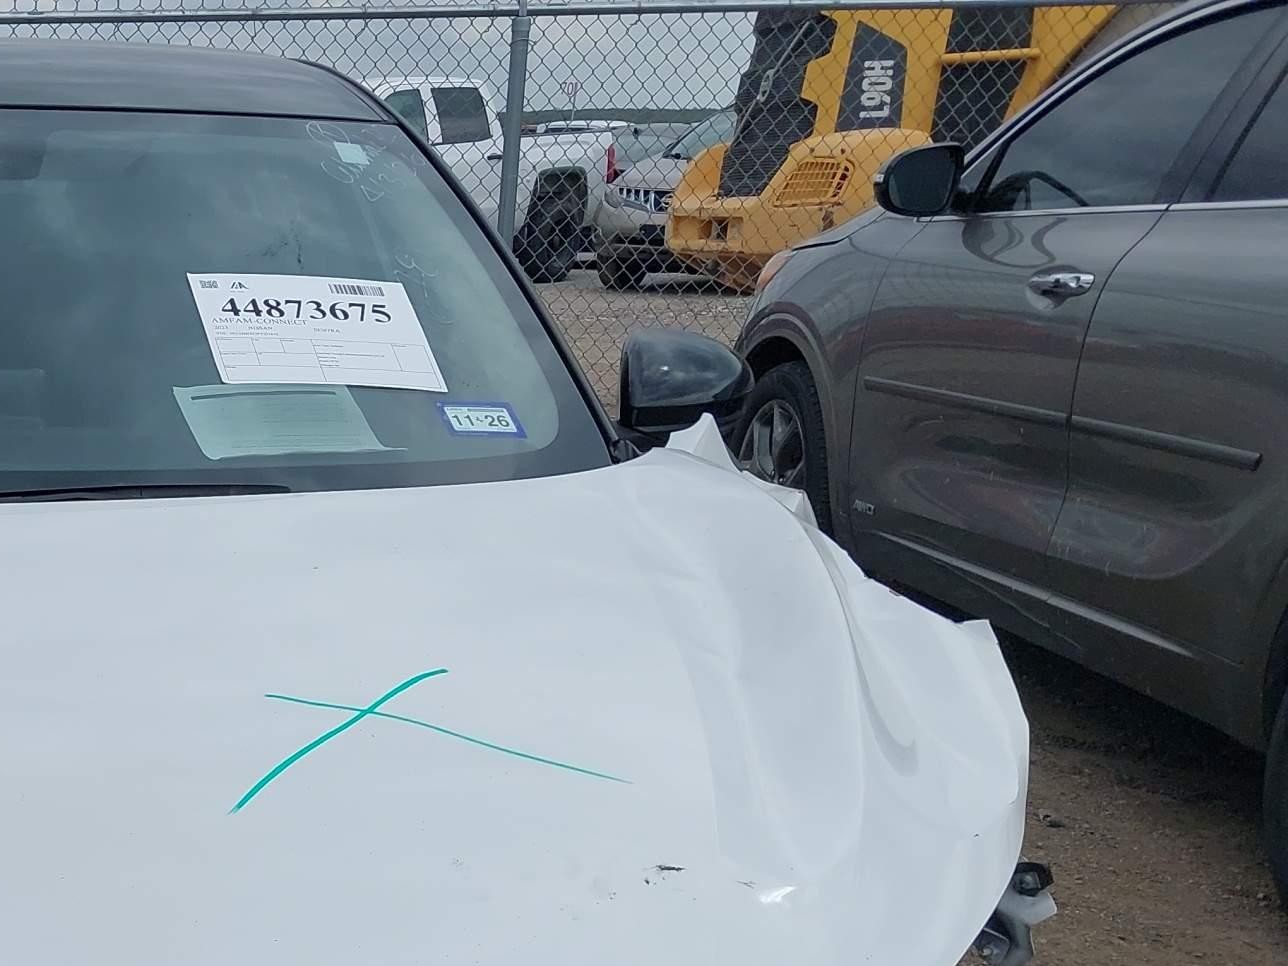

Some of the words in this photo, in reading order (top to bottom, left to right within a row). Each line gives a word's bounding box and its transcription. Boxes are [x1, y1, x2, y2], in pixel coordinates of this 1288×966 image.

[859, 60, 896, 119] L90H
[221, 297, 393, 324] 44873675
[452, 414, 475, 427] 11
[484, 414, 510, 428] 26
